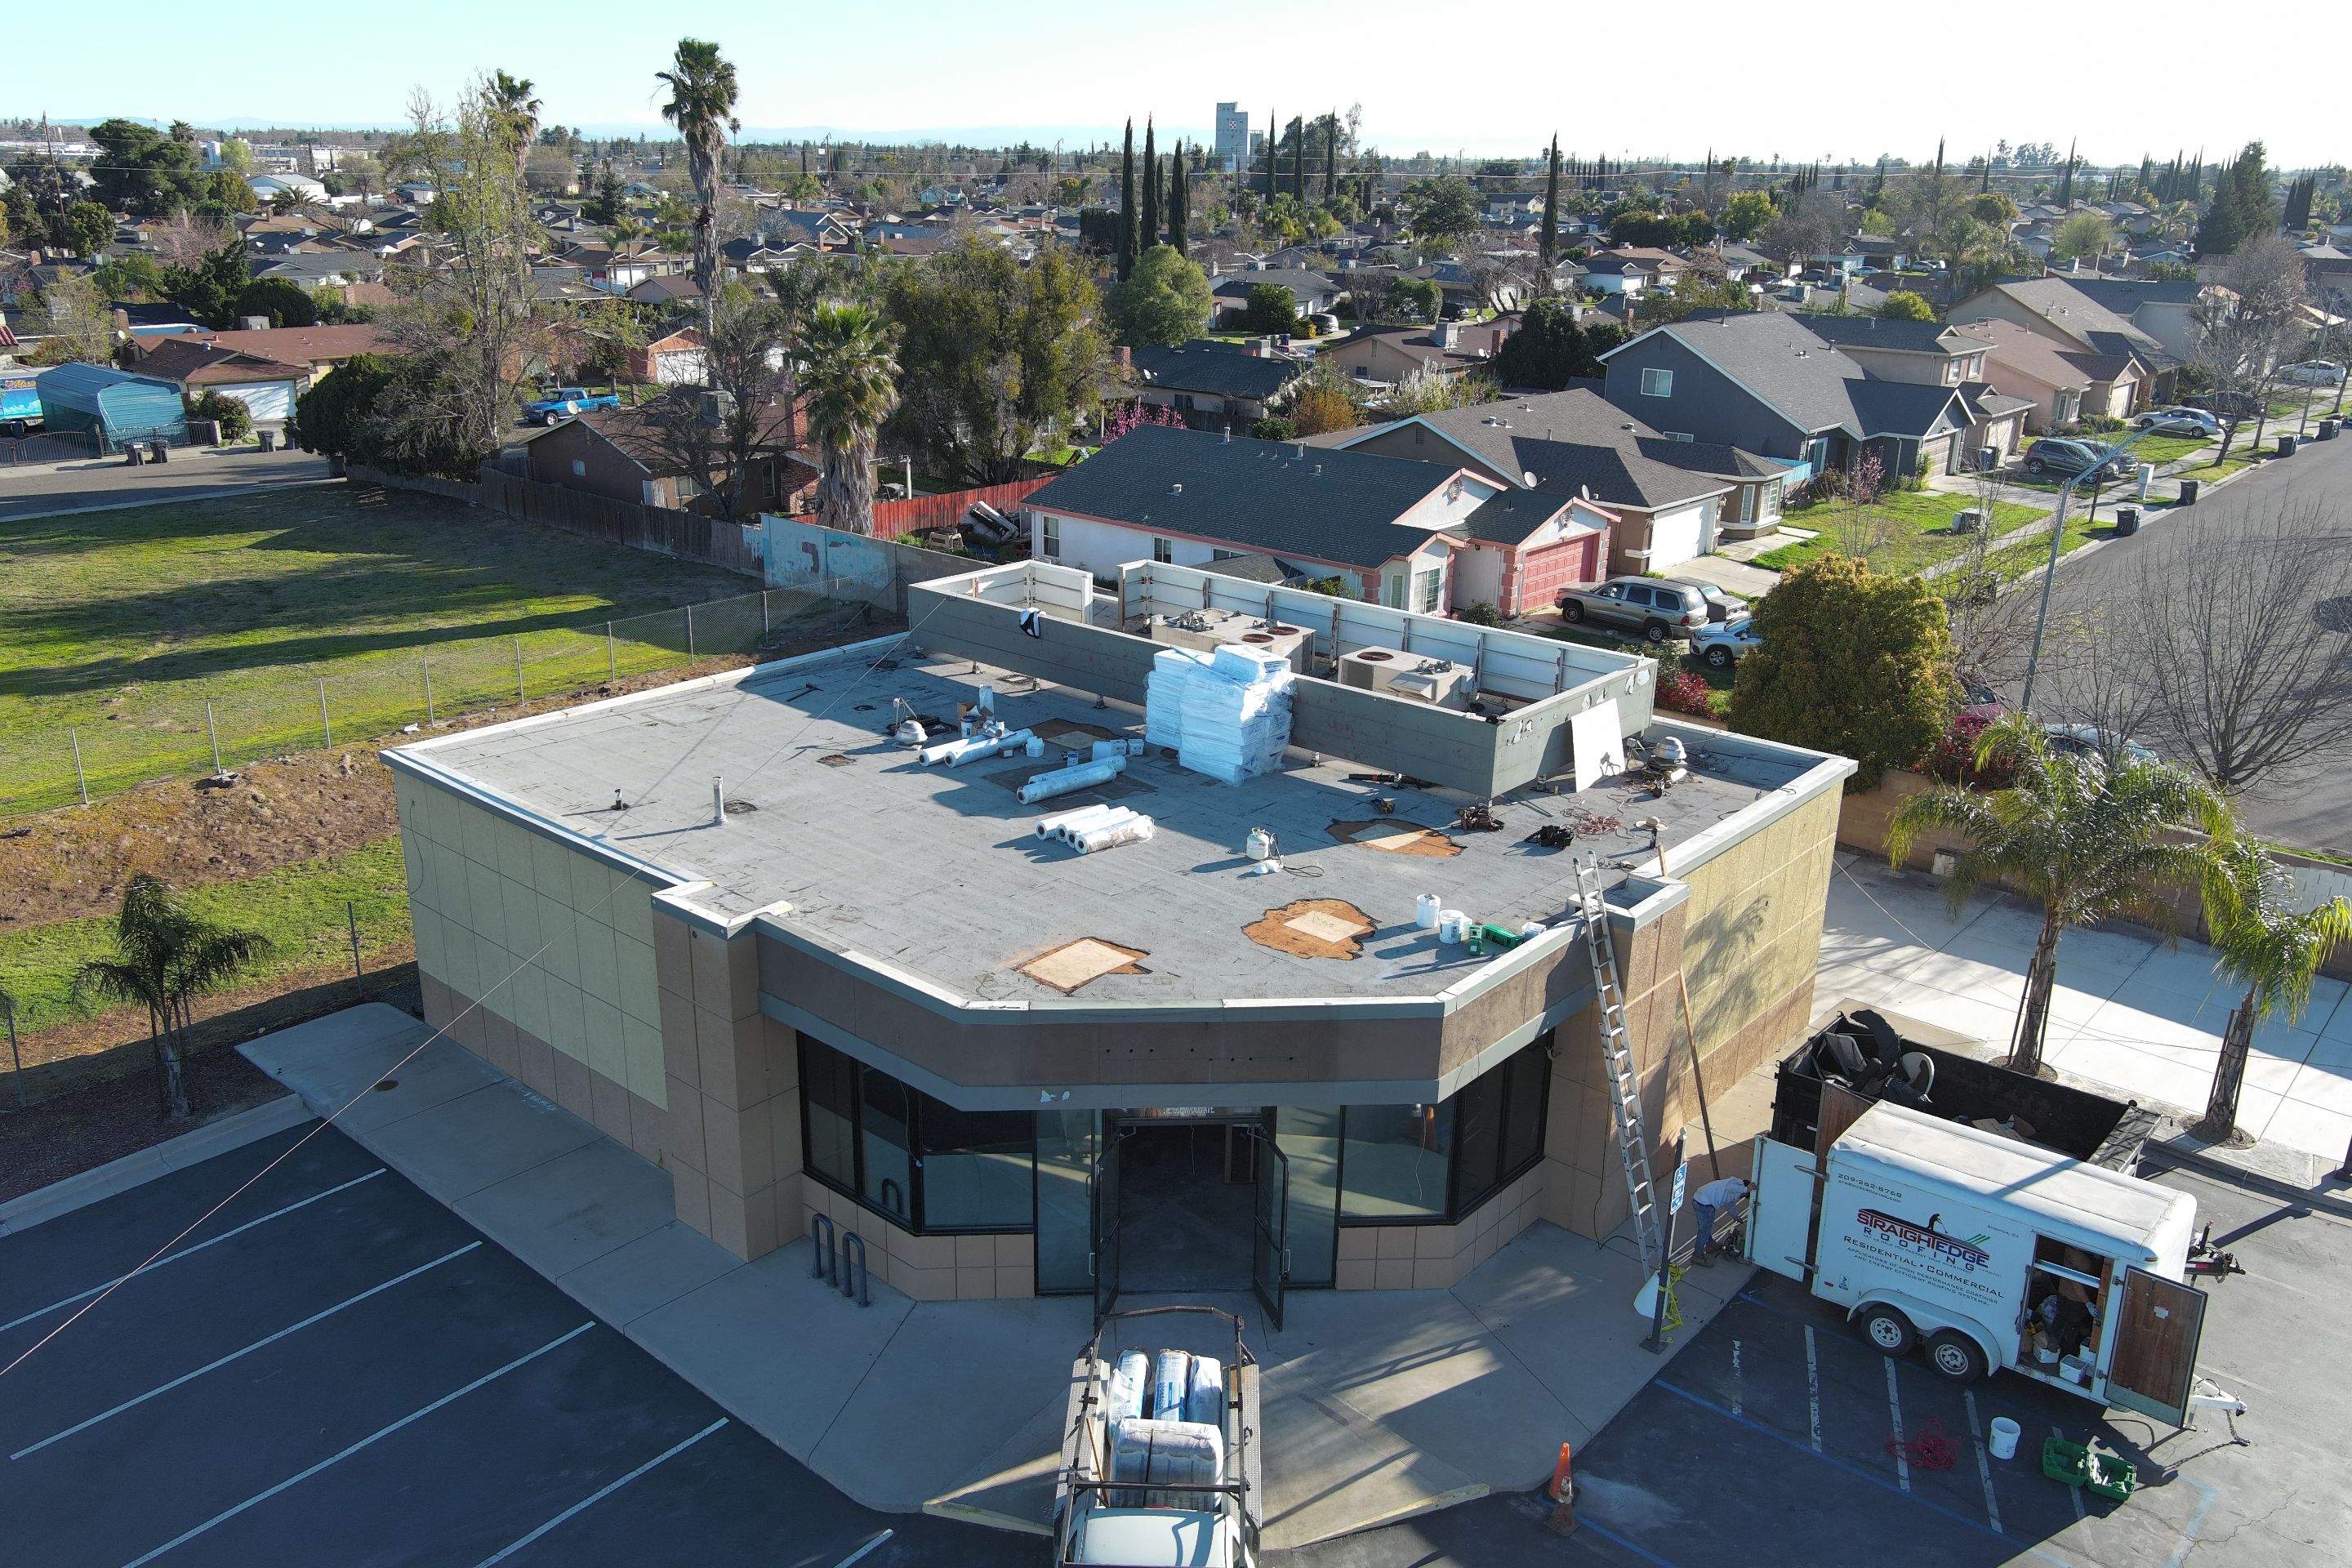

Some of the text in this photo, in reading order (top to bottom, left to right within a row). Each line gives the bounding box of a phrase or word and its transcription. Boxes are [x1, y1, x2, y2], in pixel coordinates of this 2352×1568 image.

[1843, 1235, 2004, 1298] RESIDENTIAL COMMERCIAL
[1856, 1212, 1989, 1269] STRAIGHTEDGE
[1864, 1226, 1975, 1272] ROOFING
[1846, 1247, 1887, 1264] APPLICATORS
[1965, 1290, 1998, 1304] COATINGS
[1927, 1281, 1956, 1294] ROOFING
